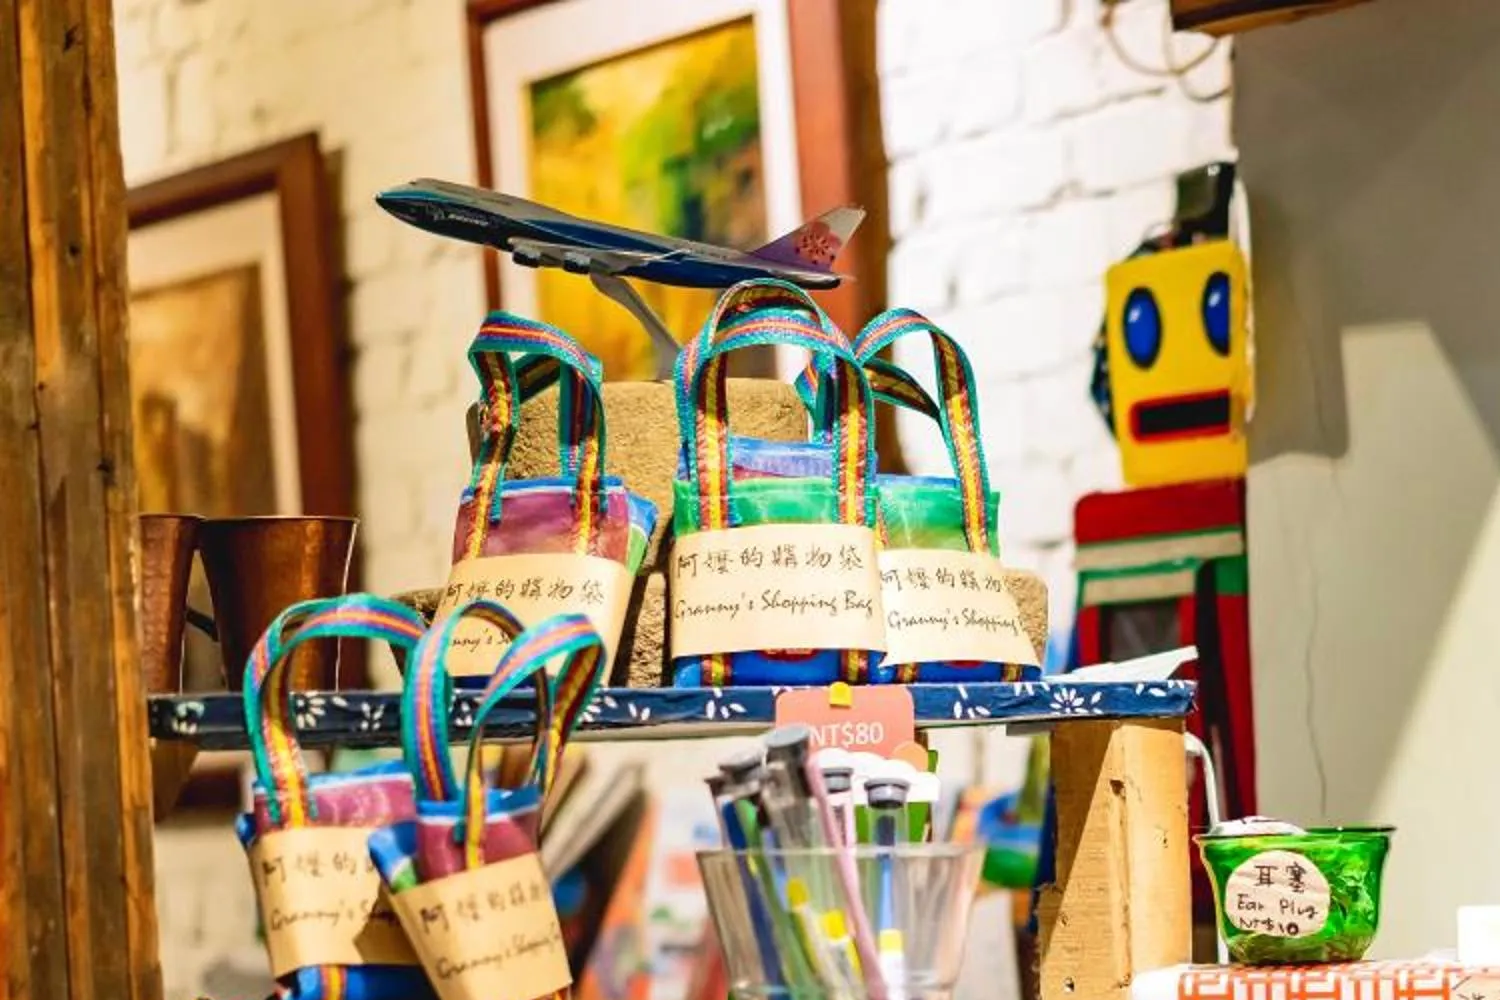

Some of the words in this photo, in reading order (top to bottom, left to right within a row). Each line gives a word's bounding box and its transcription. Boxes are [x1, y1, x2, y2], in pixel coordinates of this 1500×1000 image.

[761, 588, 838, 617] Shopping
[843, 589, 874, 620] Bag
[809, 720, 885, 747] NT$80
[1237, 893, 1265, 911] Ear
[1279, 897, 1319, 919] Plug
